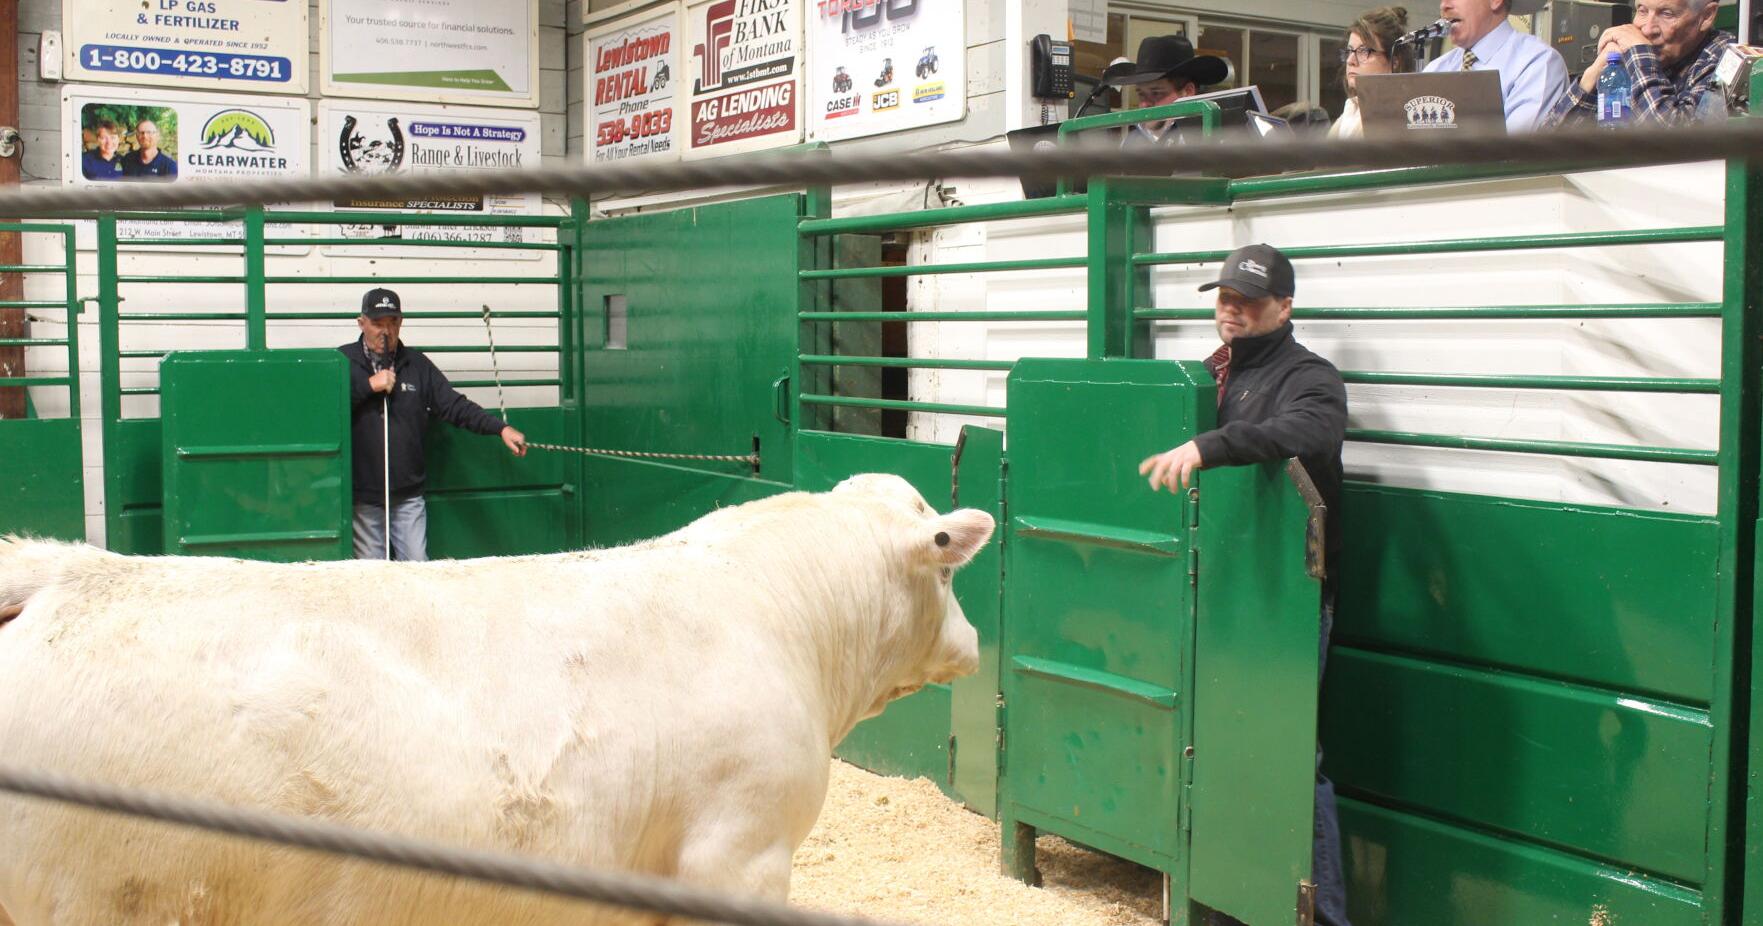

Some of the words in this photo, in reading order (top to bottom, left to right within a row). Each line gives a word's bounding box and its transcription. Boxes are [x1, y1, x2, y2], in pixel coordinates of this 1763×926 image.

[160, 0, 178, 10] LP
[186, 1, 216, 14] GAS
[735, 0, 790, 18] FIR
[137, 13, 148, 25] &
[155, 15, 239, 31] FERTILIZER
[345, 15, 364, 25] Your
[366, 17, 397, 27] trusted
[399, 20, 426, 30] source
[427, 21, 440, 30] for
[441, 23, 475, 33] financial
[477, 26, 516, 36] solutions.
[735, 8, 789, 44] BANK
[105, 32, 139, 42] LOCALLY
[142, 35, 171, 44] OWNED
[226, 41, 248, 49] SINCE
[595, 31, 671, 74] Lewistown
[722, 48, 736, 70] of
[736, 39, 792, 64] Montana
[89, 48, 282, 79] 1-800-423-8791
[727, 63, 788, 84] www.1stbmt.com
[595, 66, 648, 106] RENTAL
[619, 99, 649, 115] Phone
[696, 99, 719, 123] AG
[721, 83, 792, 118] LENDING
[827, 97, 851, 112] CASE
[873, 92, 898, 109] JCB
[1404, 96, 1455, 112] SUPERIOR
[414, 124, 440, 136] Hope
[442, 125, 451, 135] Is
[453, 126, 471, 137] Not
[473, 128, 480, 137] A
[482, 128, 523, 141] Strategy
[697, 111, 790, 145] Specialists
[412, 143, 450, 168] Range
[454, 145, 463, 166] &
[467, 146, 523, 168] Livestock
[628, 140, 650, 157] Rental
[651, 136, 671, 152] Needs
[188, 154, 287, 169] CLEARWATER
[406, 200, 477, 210] SPECIALISTS
[119, 228, 133, 236] 212
[144, 229, 161, 237] Main
